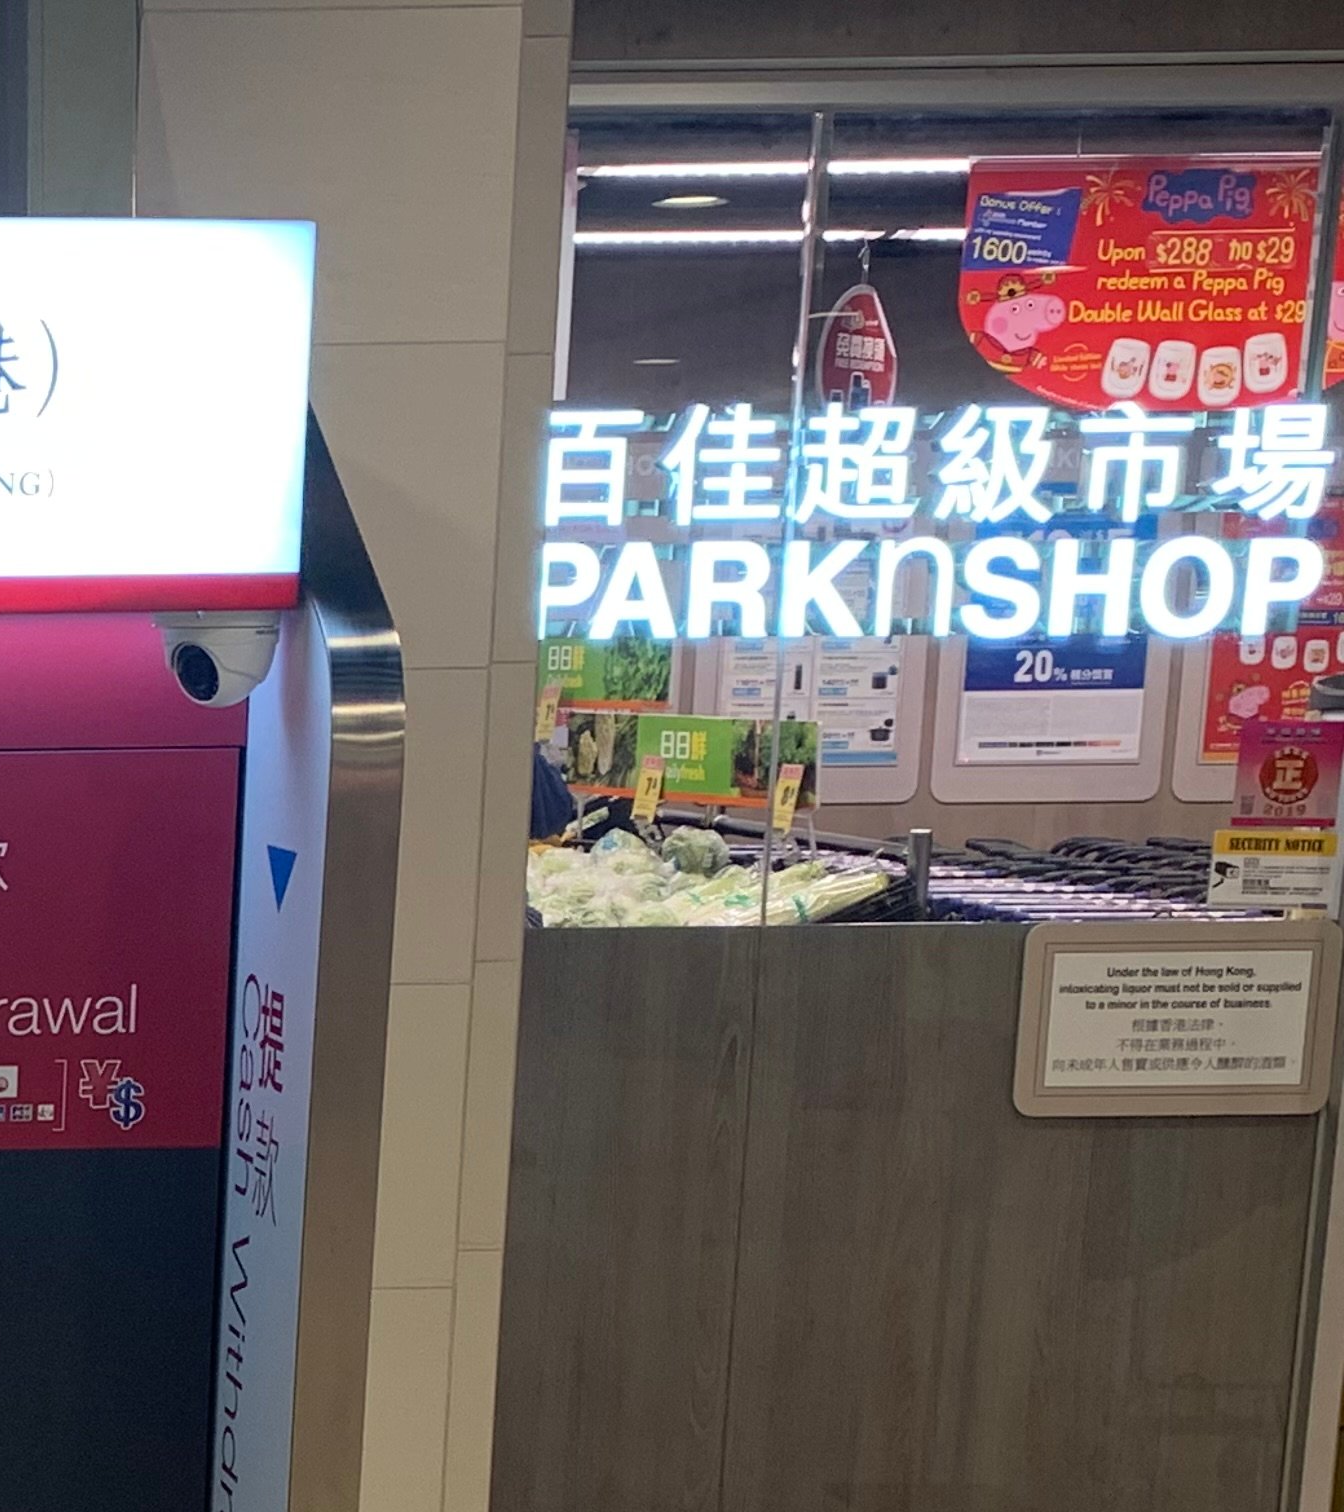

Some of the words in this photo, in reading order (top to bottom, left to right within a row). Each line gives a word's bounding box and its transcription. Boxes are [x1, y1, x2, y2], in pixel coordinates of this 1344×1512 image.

[1149, 174, 1213, 217] Peppa
[1218, 174, 1252, 214] Pig
[972, 236, 1027, 264] 1600
[1098, 239, 1146, 266] Upon
[1156, 237, 1213, 266] $288
[1097, 269, 1168, 290] redeem
[1173, 277, 1186, 290] a
[1192, 269, 1248, 296] Peppa
[1253, 268, 1285, 296] Pig
[1069, 302, 1133, 322] Double
[1137, 300, 1183, 322] Wall
[1188, 300, 1242, 322] Glass
[1247, 301, 1268, 320] at
[1275, 301, 1307, 323] $29
[543, 403, 1334, 523] 百佳超級市場
[1014, 650, 1067, 683] 20%
[1272, 760, 1304, 790] 正
[1263, 803, 1307, 817] 2019
[1229, 837, 1280, 851] SECURITY
[1284, 838, 1324, 852] NOTICE
[1107, 967, 1140, 978] Under
[1141, 967, 1159, 977] the
[1161, 967, 1178, 977] law
[1181, 967, 1193, 977] of
[1195, 967, 1223, 979] Hong
[1059, 983, 1120, 995] intoxicating
[1122, 983, 1152, 995] liquor
[1154, 983, 1181, 993] must
[1183, 983, 1201, 993] not
[1202, 982, 1215, 993] be
[1218, 982, 1240, 992] sold
[1242, 983, 1255, 992] or
[1257, 981, 1302, 994] supplied
[1085, 1000, 1097, 1010] to
[1107, 999, 1137, 1009] minor
[1139, 999, 1150, 1009] in
[1152, 999, 1169, 1009] the
[1171, 1000, 1207, 1009] course
[1209, 998, 1221, 1008] of
[234, 973, 261, 1197] Cash
[252, 984, 285, 1228] 提款
